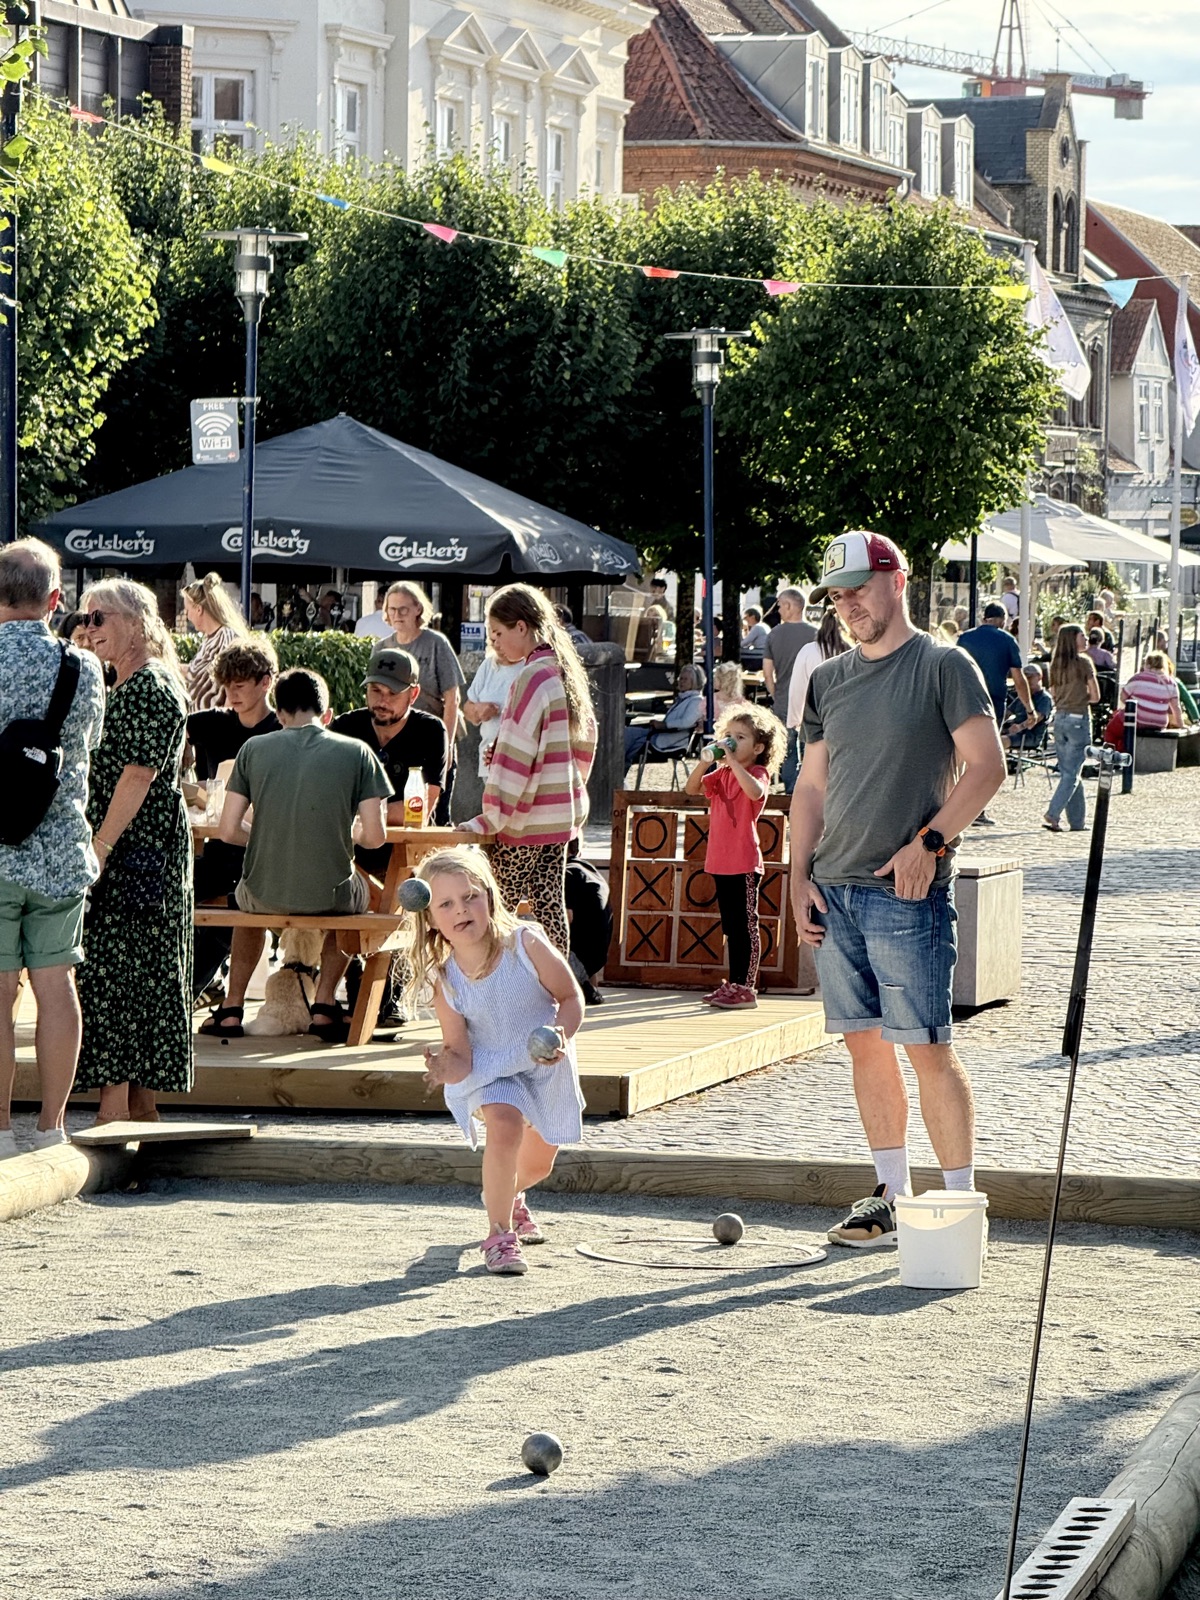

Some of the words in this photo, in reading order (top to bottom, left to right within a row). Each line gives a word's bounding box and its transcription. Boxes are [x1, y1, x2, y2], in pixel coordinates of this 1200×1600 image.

[203, 402, 225, 410] FREE
[201, 437, 230, 448] Wi-Fi
[64, 528, 155, 559] Carlsberg
[221, 527, 310, 557] Calsberg
[378, 535, 468, 568] Carlsberg
